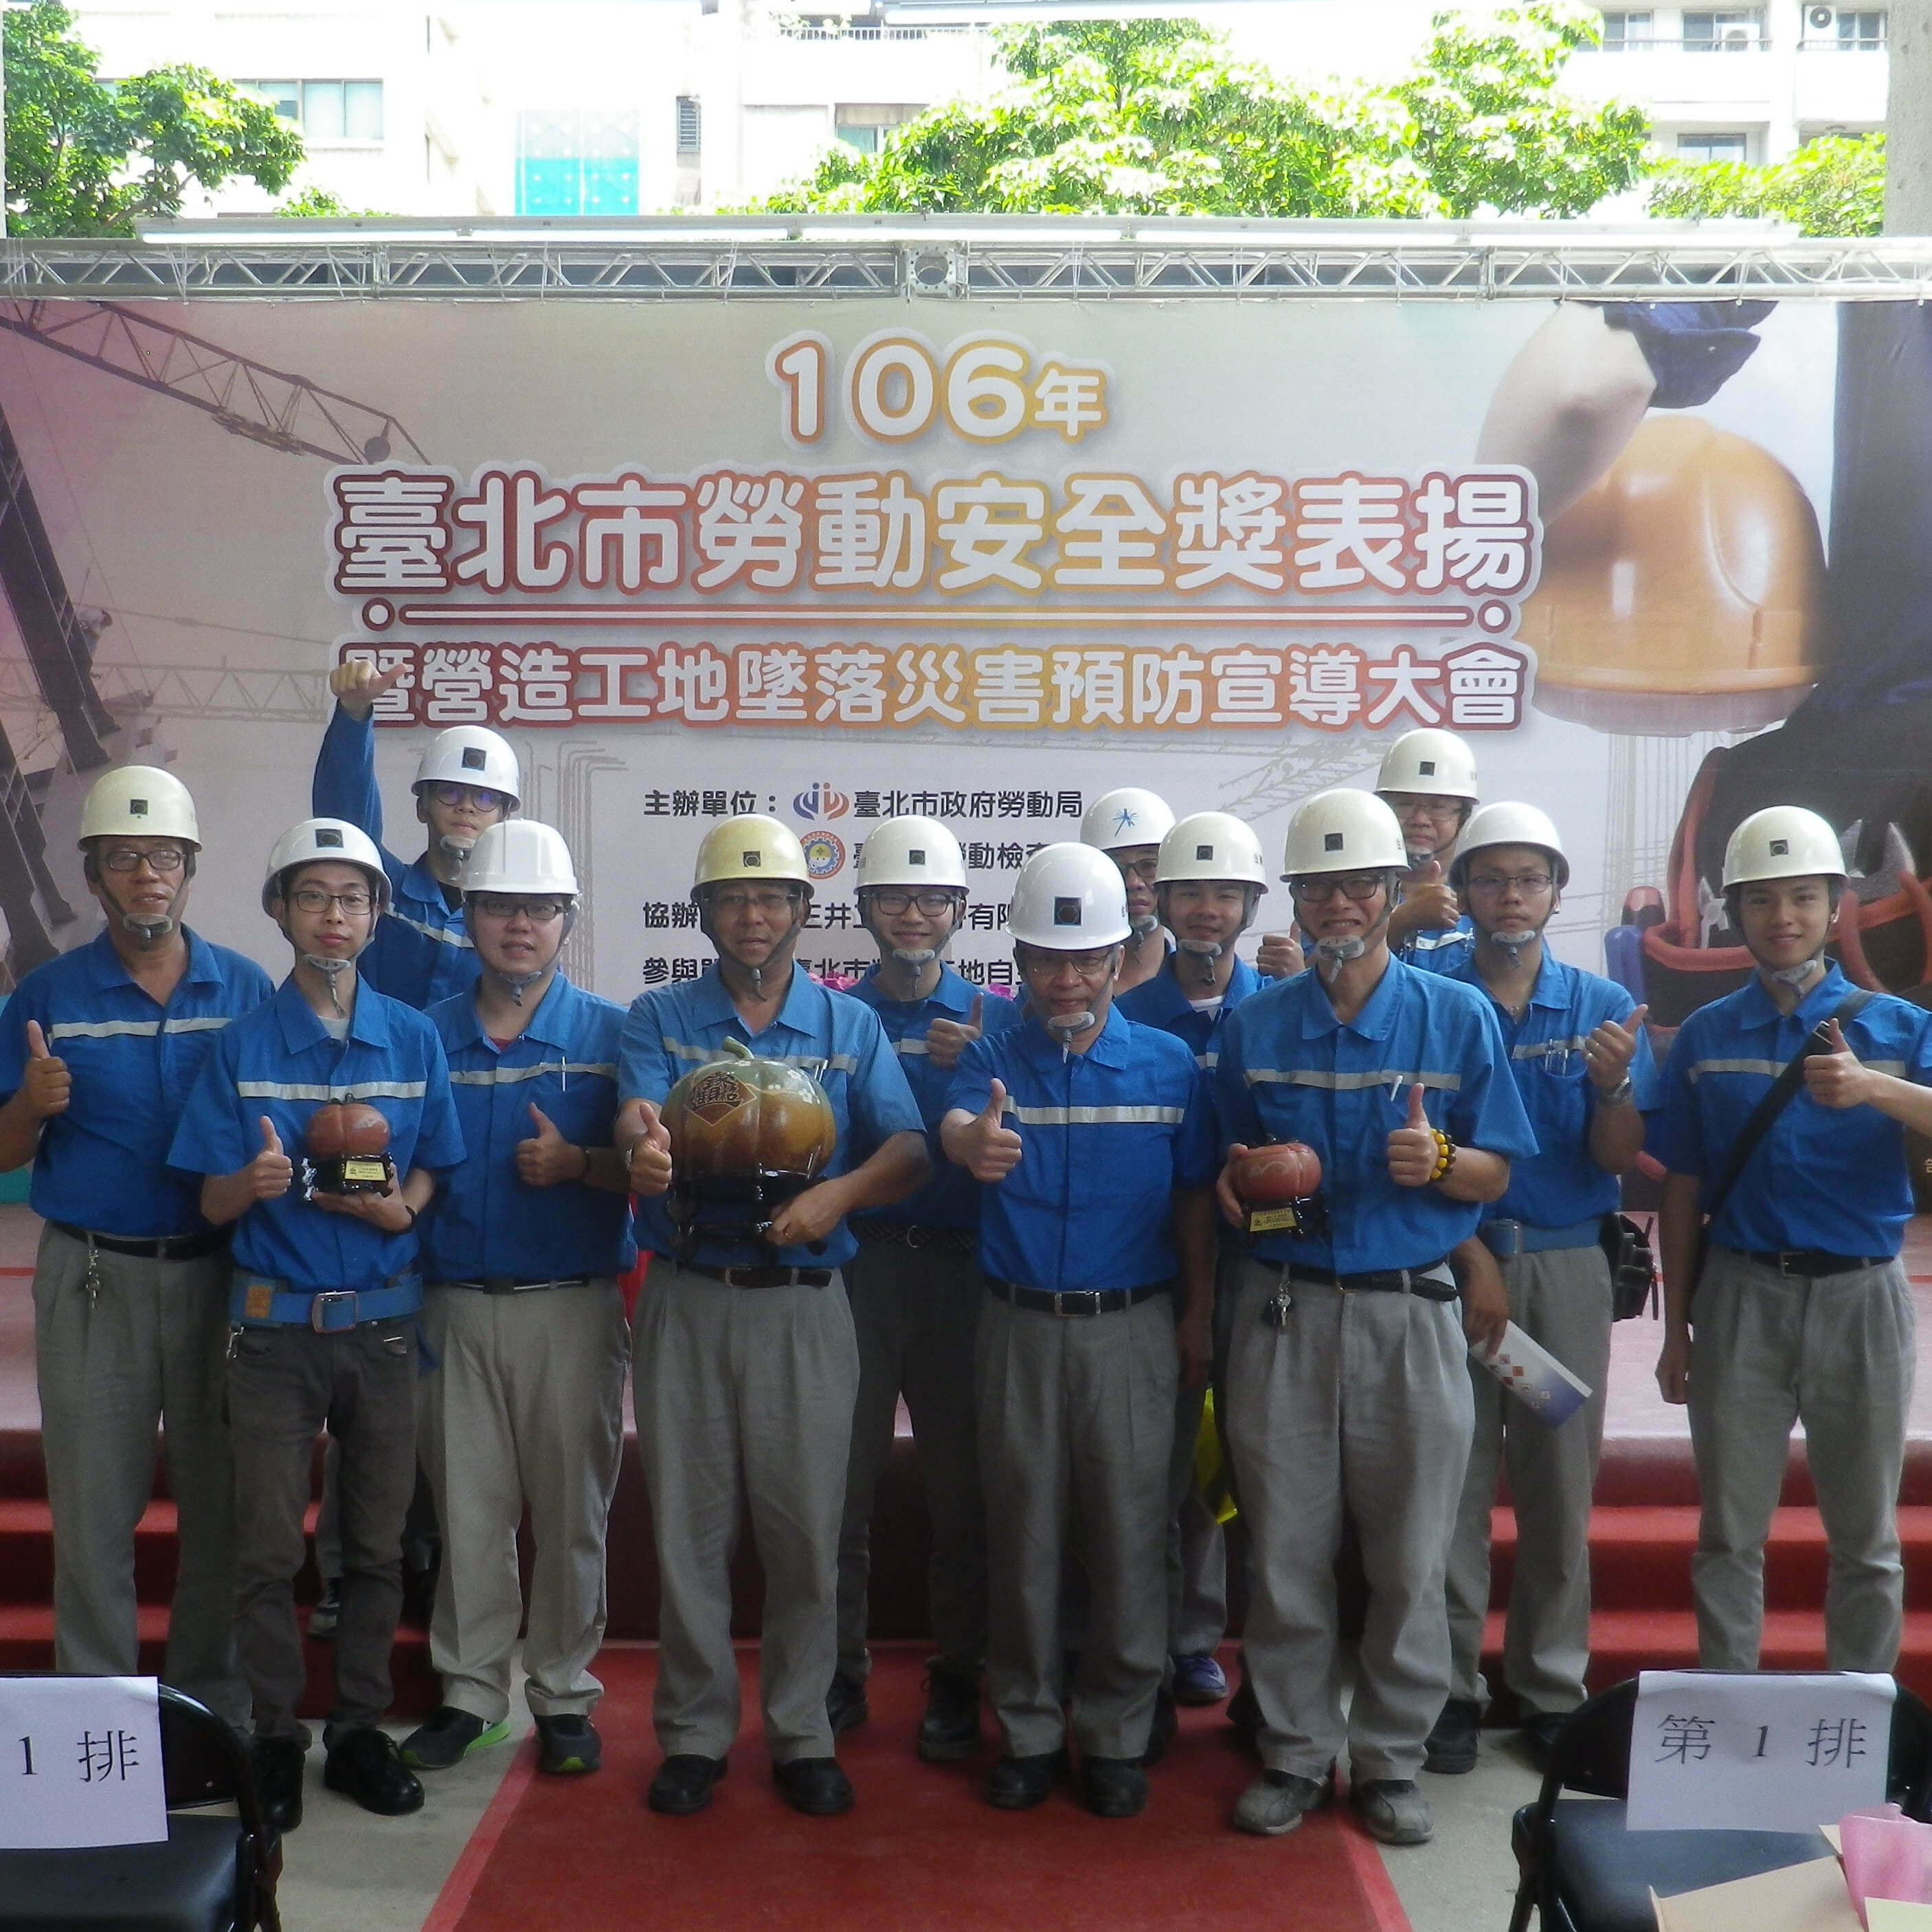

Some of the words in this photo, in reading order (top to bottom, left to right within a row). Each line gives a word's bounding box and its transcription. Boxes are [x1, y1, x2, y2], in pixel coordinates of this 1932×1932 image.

[776, 339, 1108, 444] 106年
[334, 471, 1532, 595] 臺北市勞動安全獎表揚
[853, 789, 1083, 818] 臺北市政府勞動局
[643, 957, 717, 984] 參與
[18, 1736, 38, 1776] 1
[76, 1730, 140, 1782] 排
[1654, 1714, 1715, 1764] 第
[1753, 1725, 1768, 1757] 1
[1805, 1718, 1867, 1769] 排
